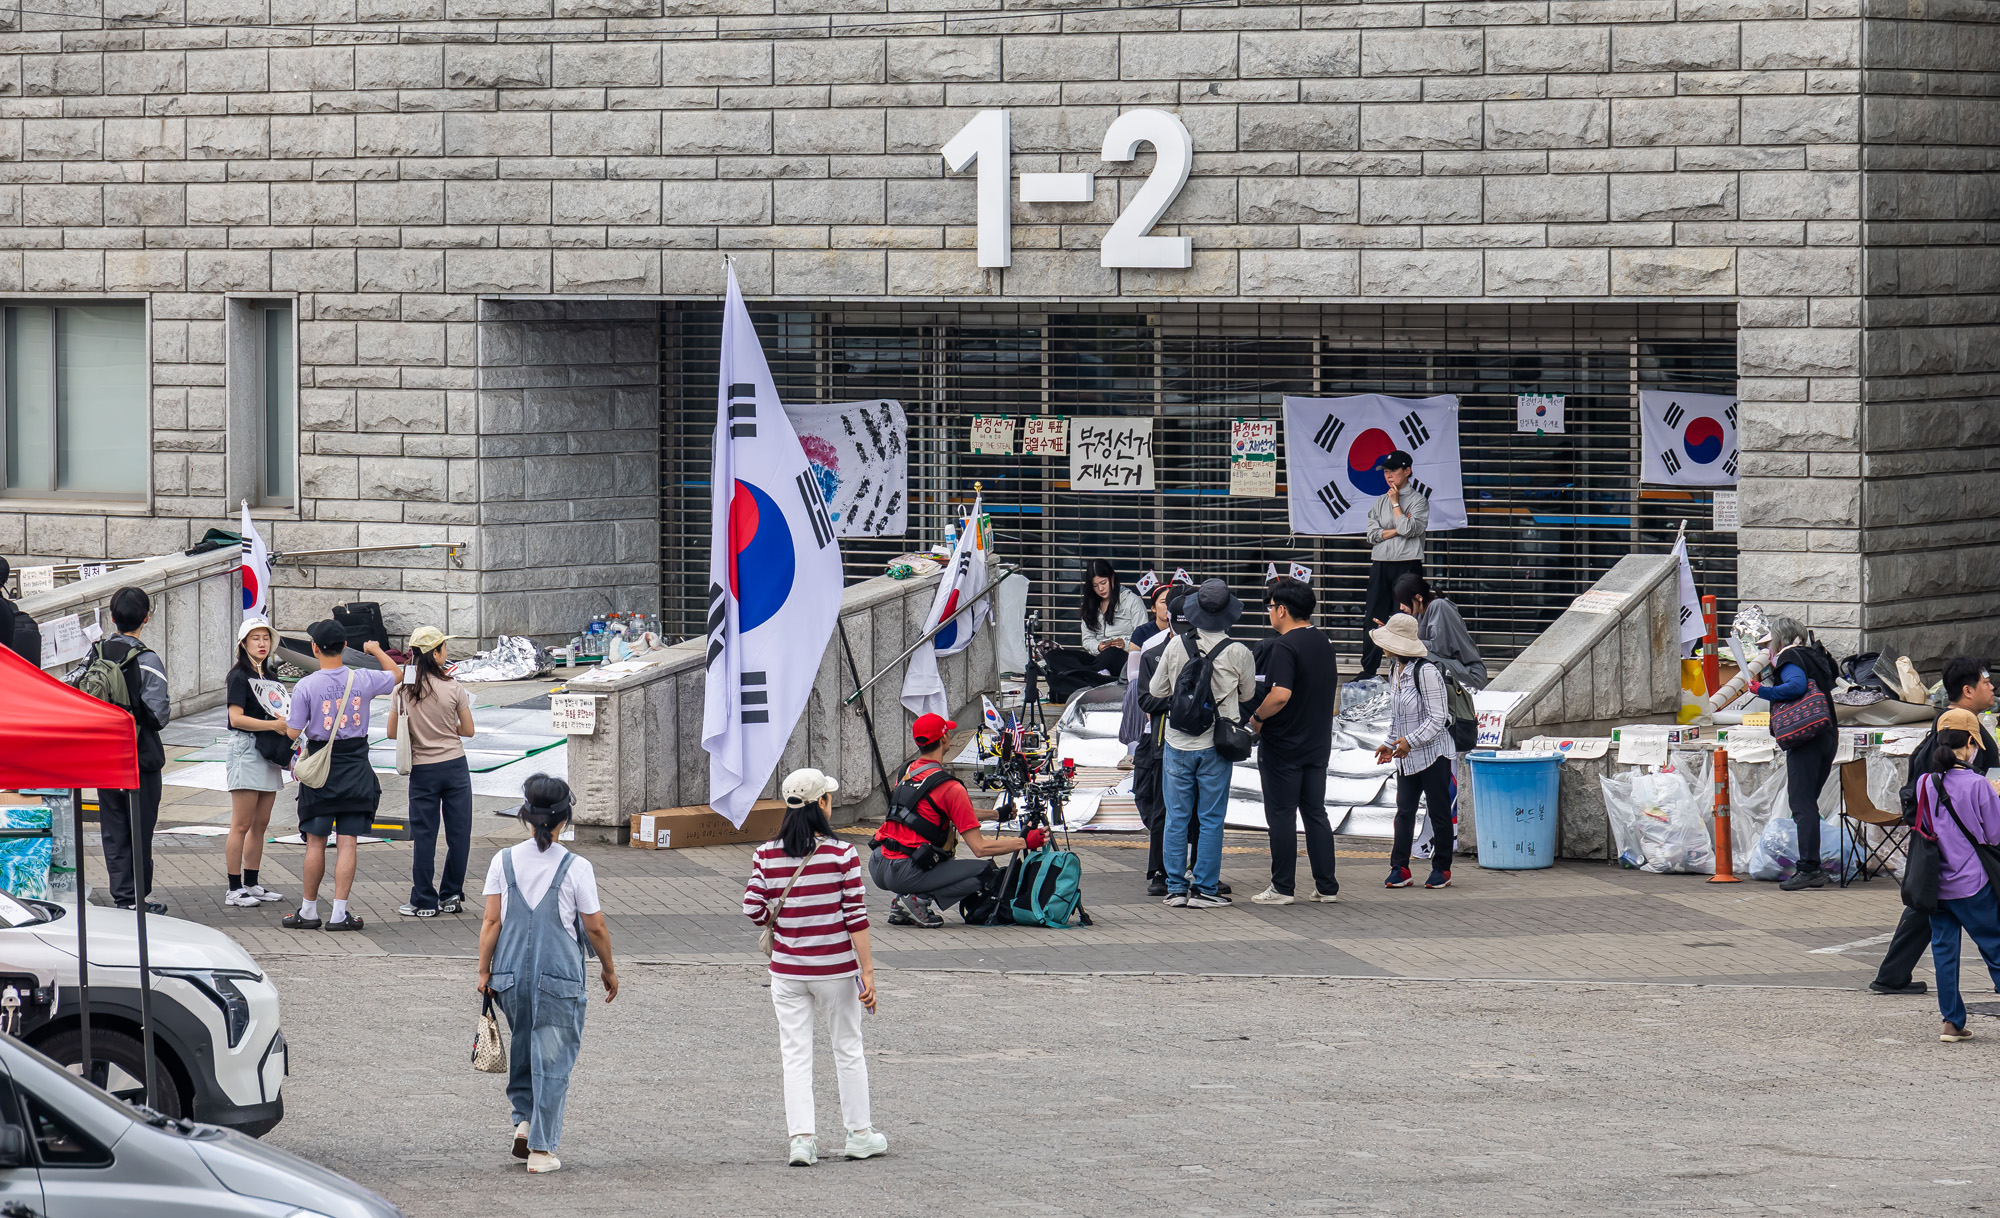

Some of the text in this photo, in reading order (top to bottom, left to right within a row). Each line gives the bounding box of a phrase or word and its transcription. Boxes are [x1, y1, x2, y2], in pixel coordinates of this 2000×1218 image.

[940, 108, 1193, 268] 1-2
[974, 418, 1014, 433] 부정선거
[1028, 420, 1063, 434] 당일 투표
[1233, 422, 1273, 438] 부정선거
[972, 441, 1012, 450] STOP THE STEAL
[1077, 426, 1152, 460] 부정선거
[1248, 439, 1276, 453] 재선거
[1077, 464, 1143, 487] 재선거
[327, 684, 346, 692] CLEA
[657, 832, 670, 844] JP
